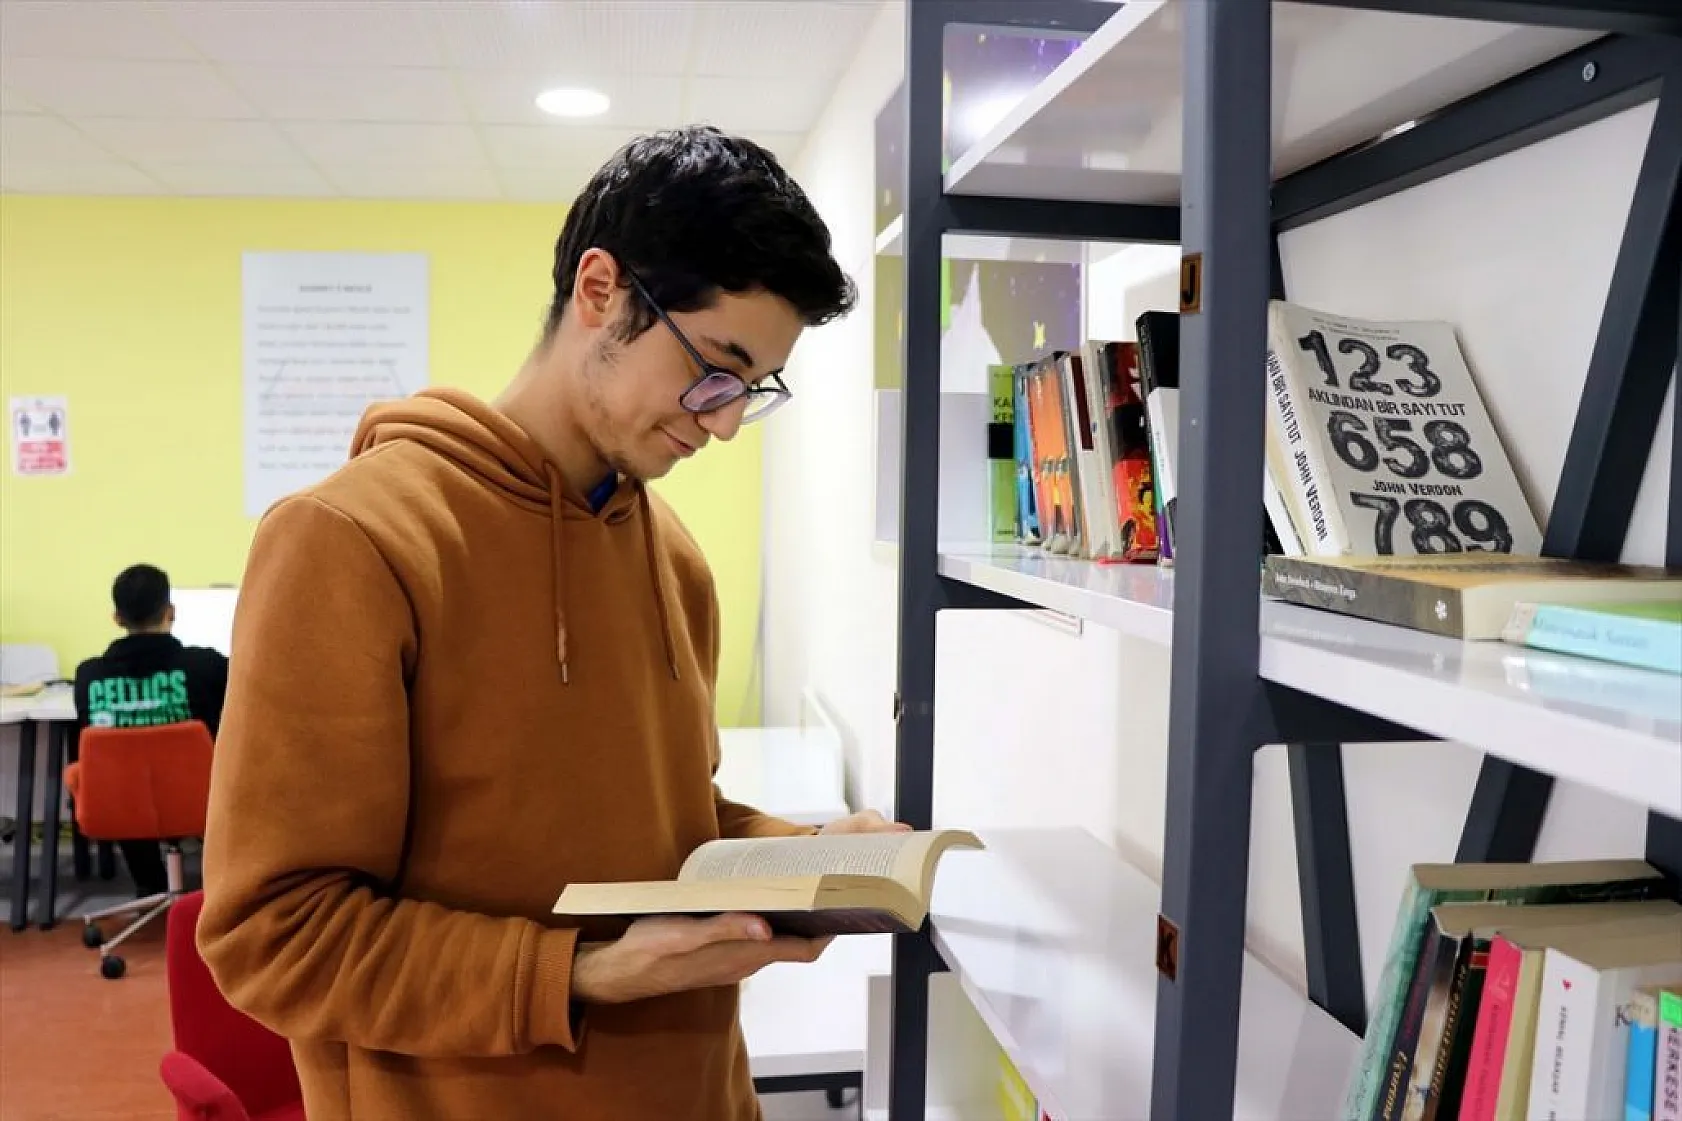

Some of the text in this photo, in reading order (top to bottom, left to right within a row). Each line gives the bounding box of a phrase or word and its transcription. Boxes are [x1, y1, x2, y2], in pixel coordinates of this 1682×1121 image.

[1182, 264, 1196, 304] J
[1297, 329, 1441, 398] 123
[1308, 388, 1375, 412] AKLINDAN
[1401, 403, 1437, 416] SAYI
[1437, 403, 1466, 416] TUT
[1286, 420, 1302, 445] TUT
[1326, 409, 1483, 480] 658
[1294, 450, 1328, 541] JOHN VERDON
[1373, 480, 1464, 496] JOHN VERDON
[1349, 491, 1513, 556] 789
[89, 670, 188, 711] CELTICS
